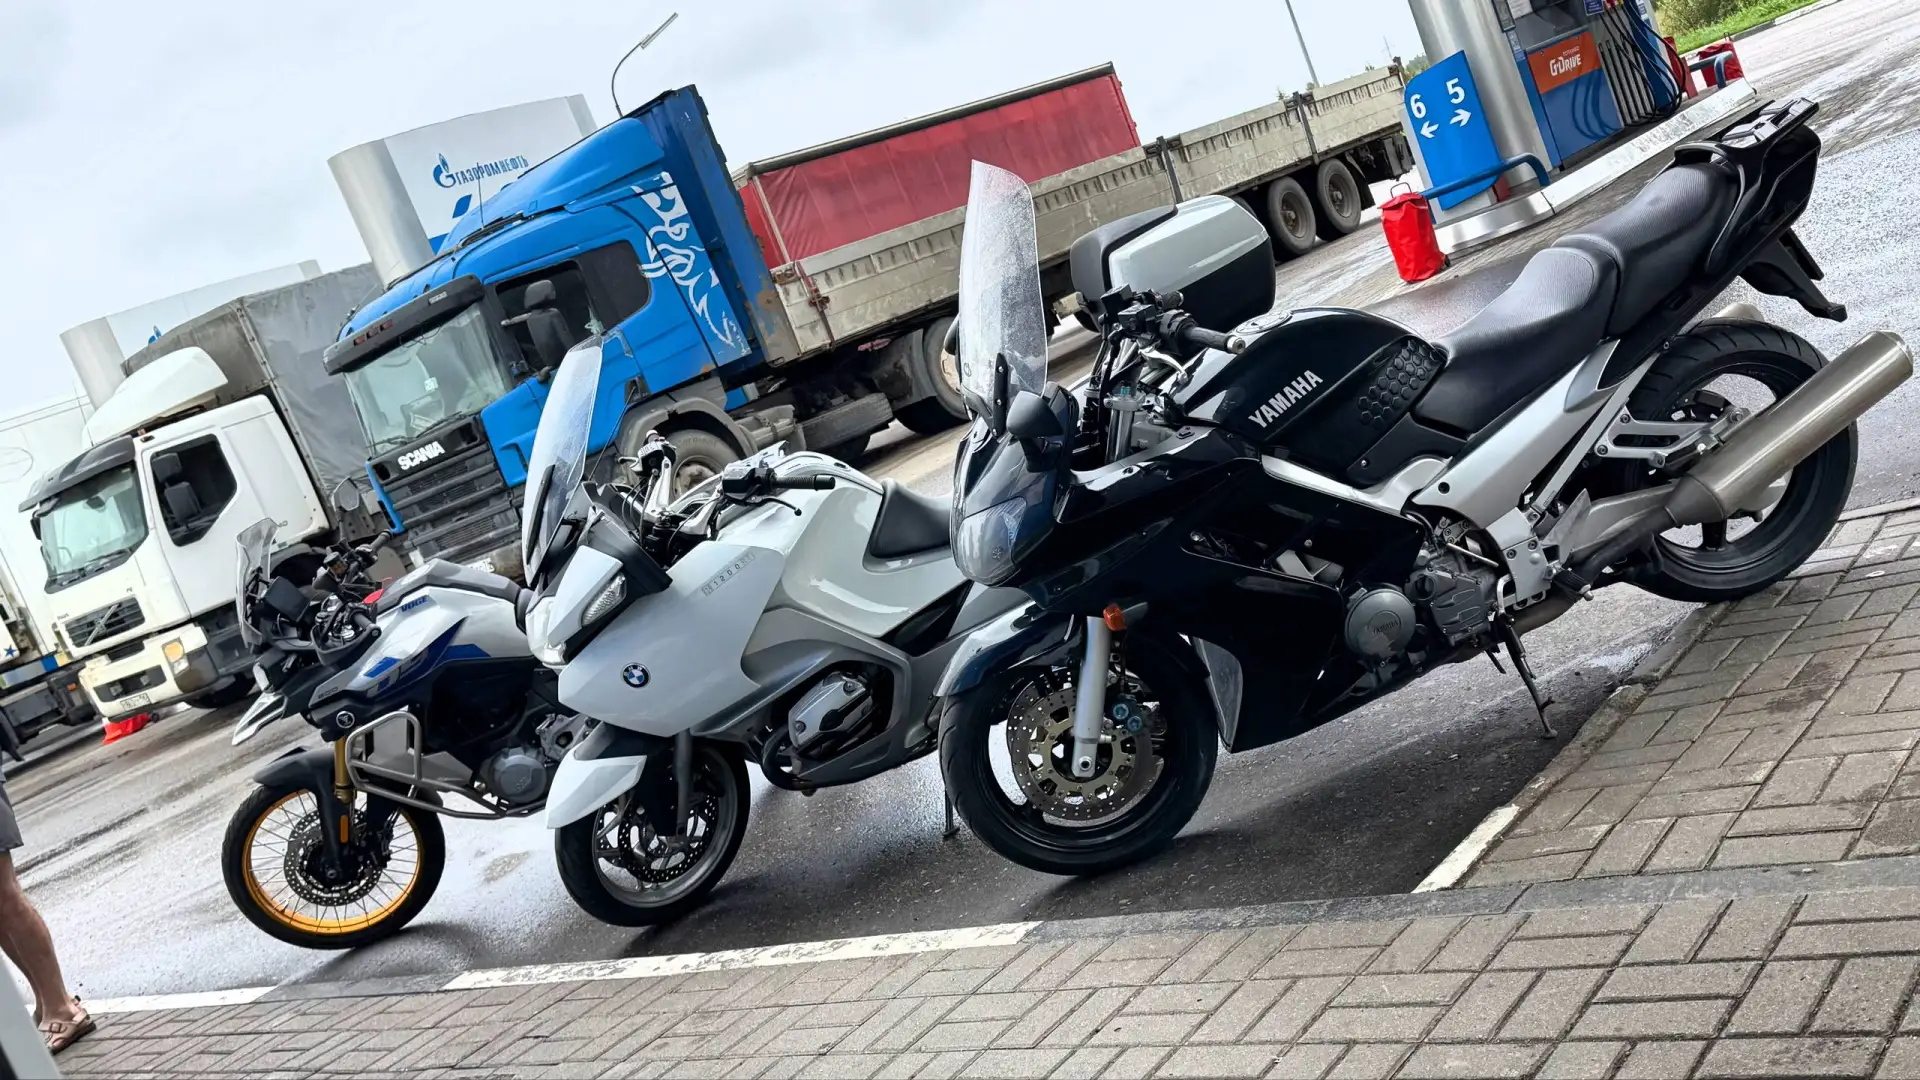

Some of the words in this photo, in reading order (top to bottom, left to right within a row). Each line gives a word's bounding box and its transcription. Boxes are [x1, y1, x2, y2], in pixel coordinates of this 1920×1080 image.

[1445, 77, 1466, 105] 5
[1410, 93, 1427, 119] 6
[1247, 369, 1324, 429] YAMAHA
[397, 440, 446, 471] SCANIA
[401, 596, 427, 613] VOGE
